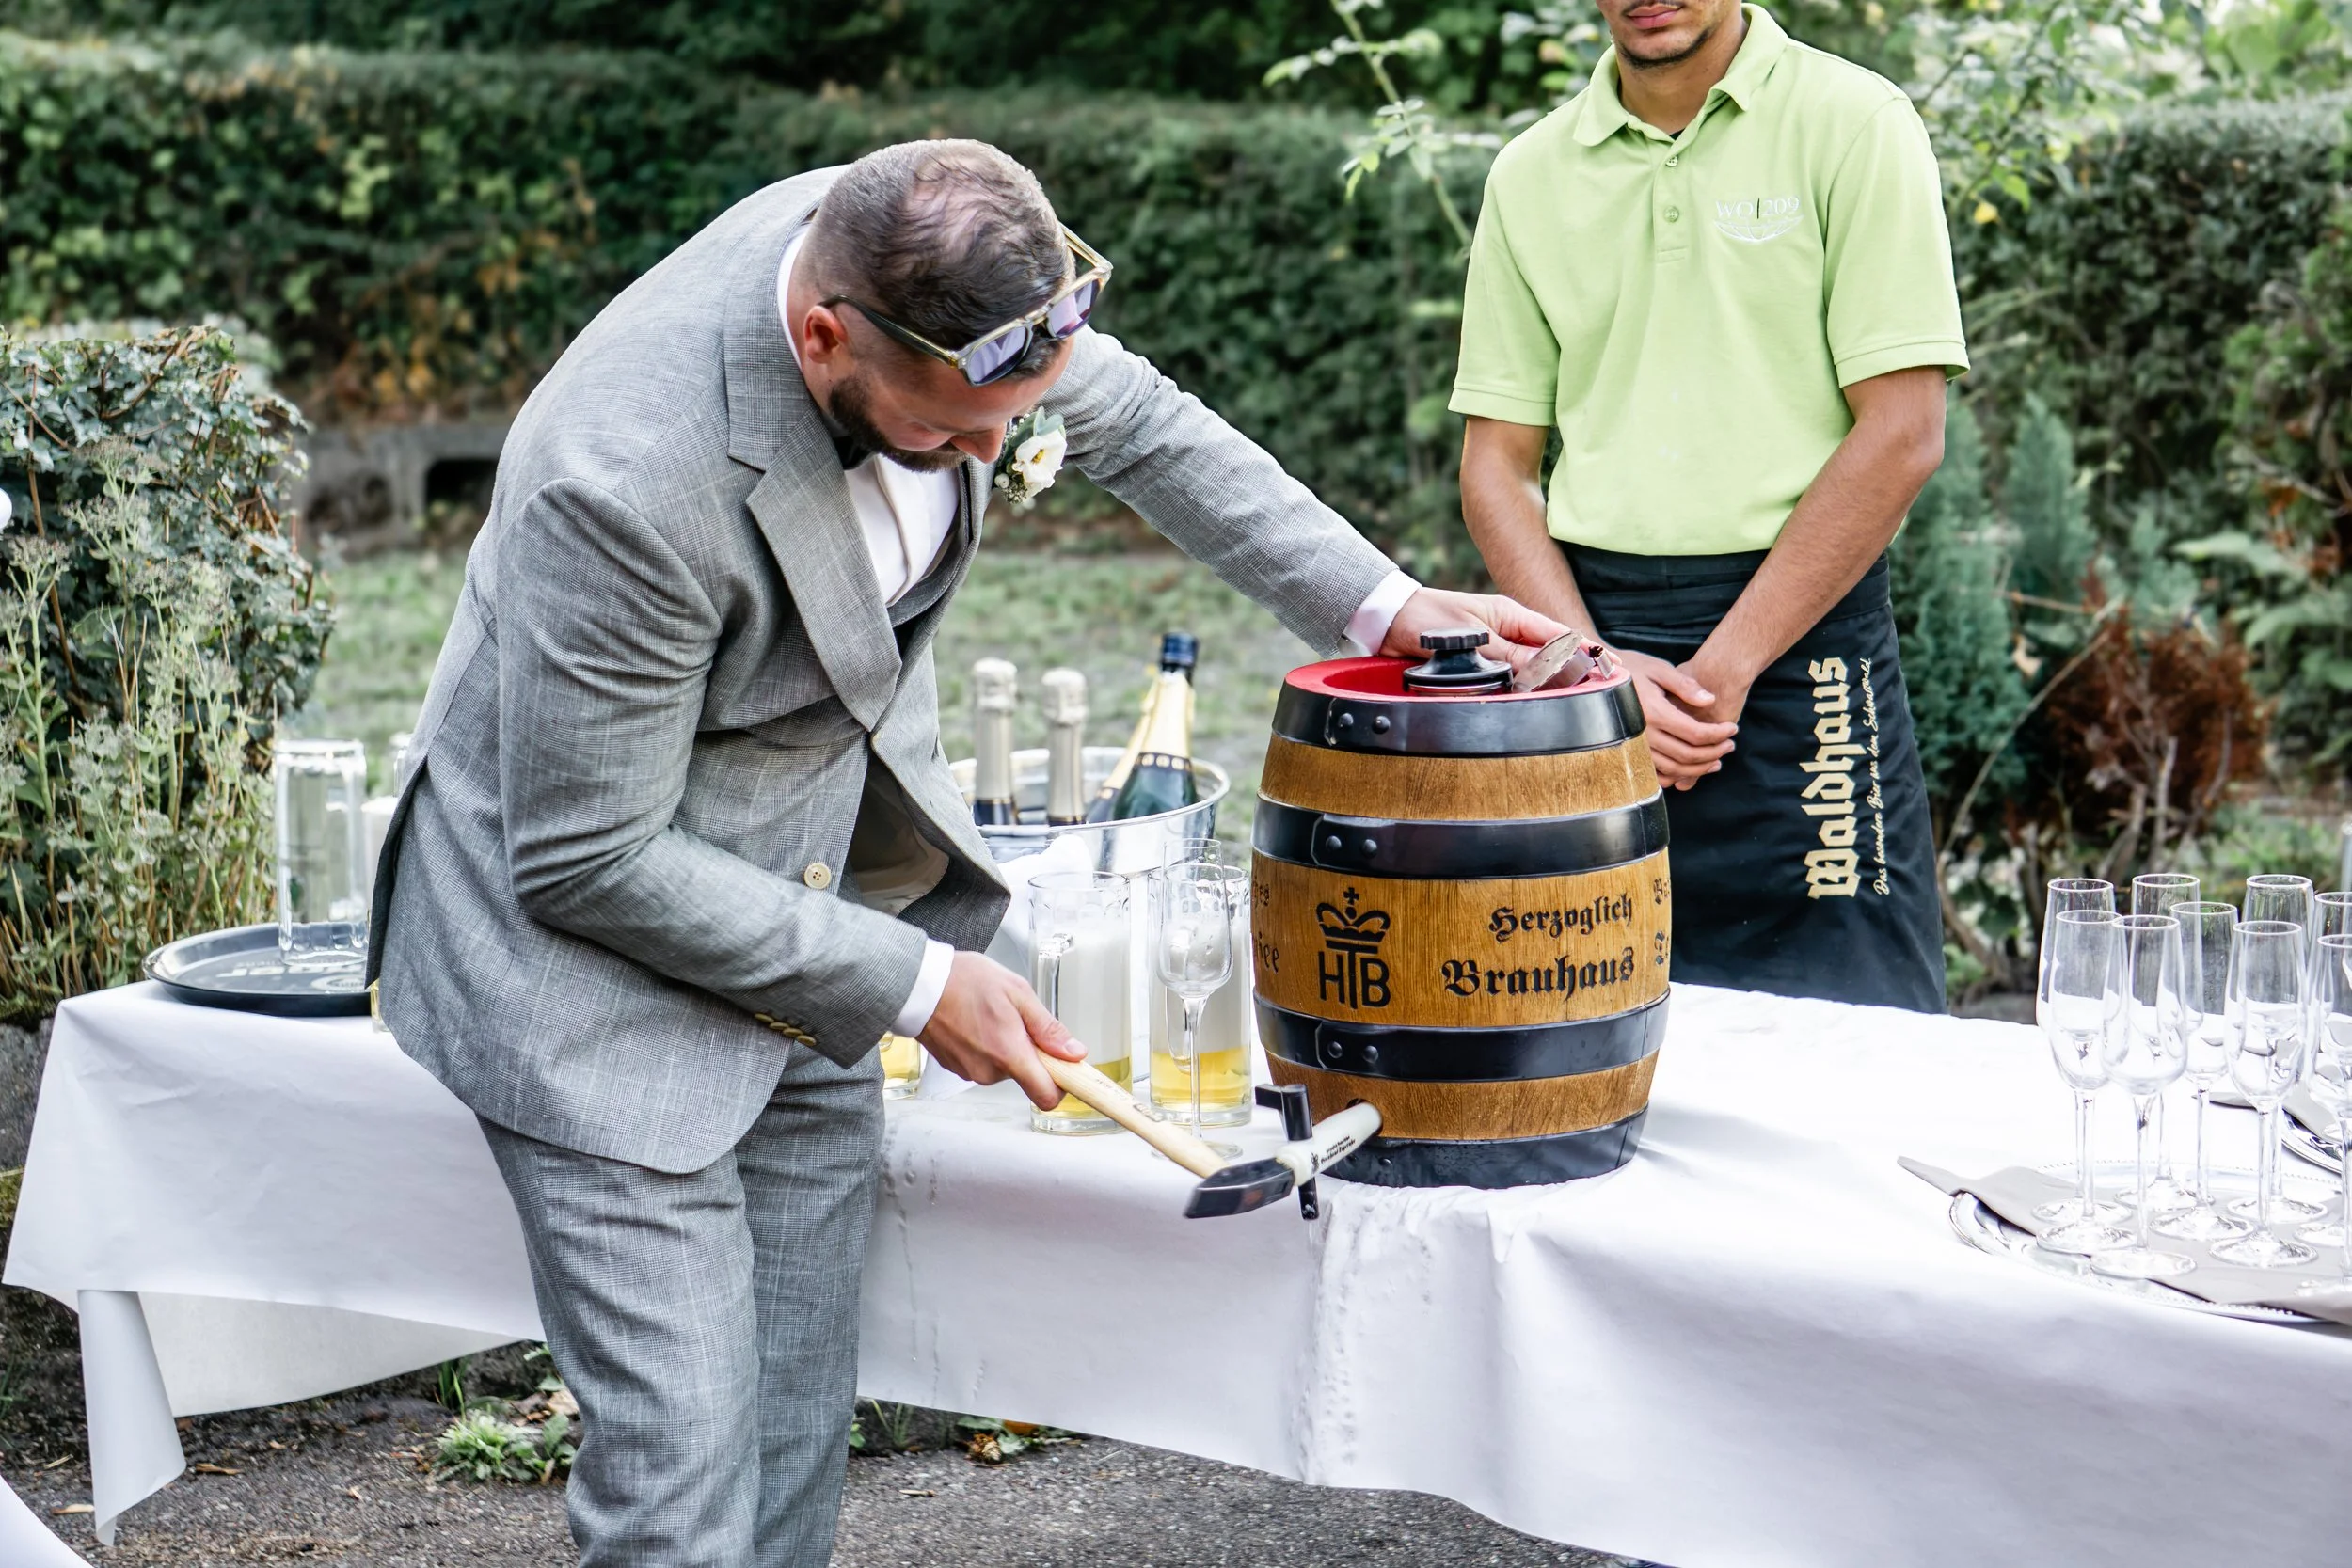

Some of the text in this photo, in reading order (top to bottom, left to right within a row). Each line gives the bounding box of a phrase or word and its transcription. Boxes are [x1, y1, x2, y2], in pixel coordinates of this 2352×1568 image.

[1799, 657, 1867, 900] Waldhaus
[1867, 781, 1884, 809] Bier
[1873, 868, 1890, 895] Das
[1487, 892, 1633, 943] Herzoglich
[1318, 939, 1391, 1009] HTB
[1440, 946, 1635, 1002] Brauhaus
